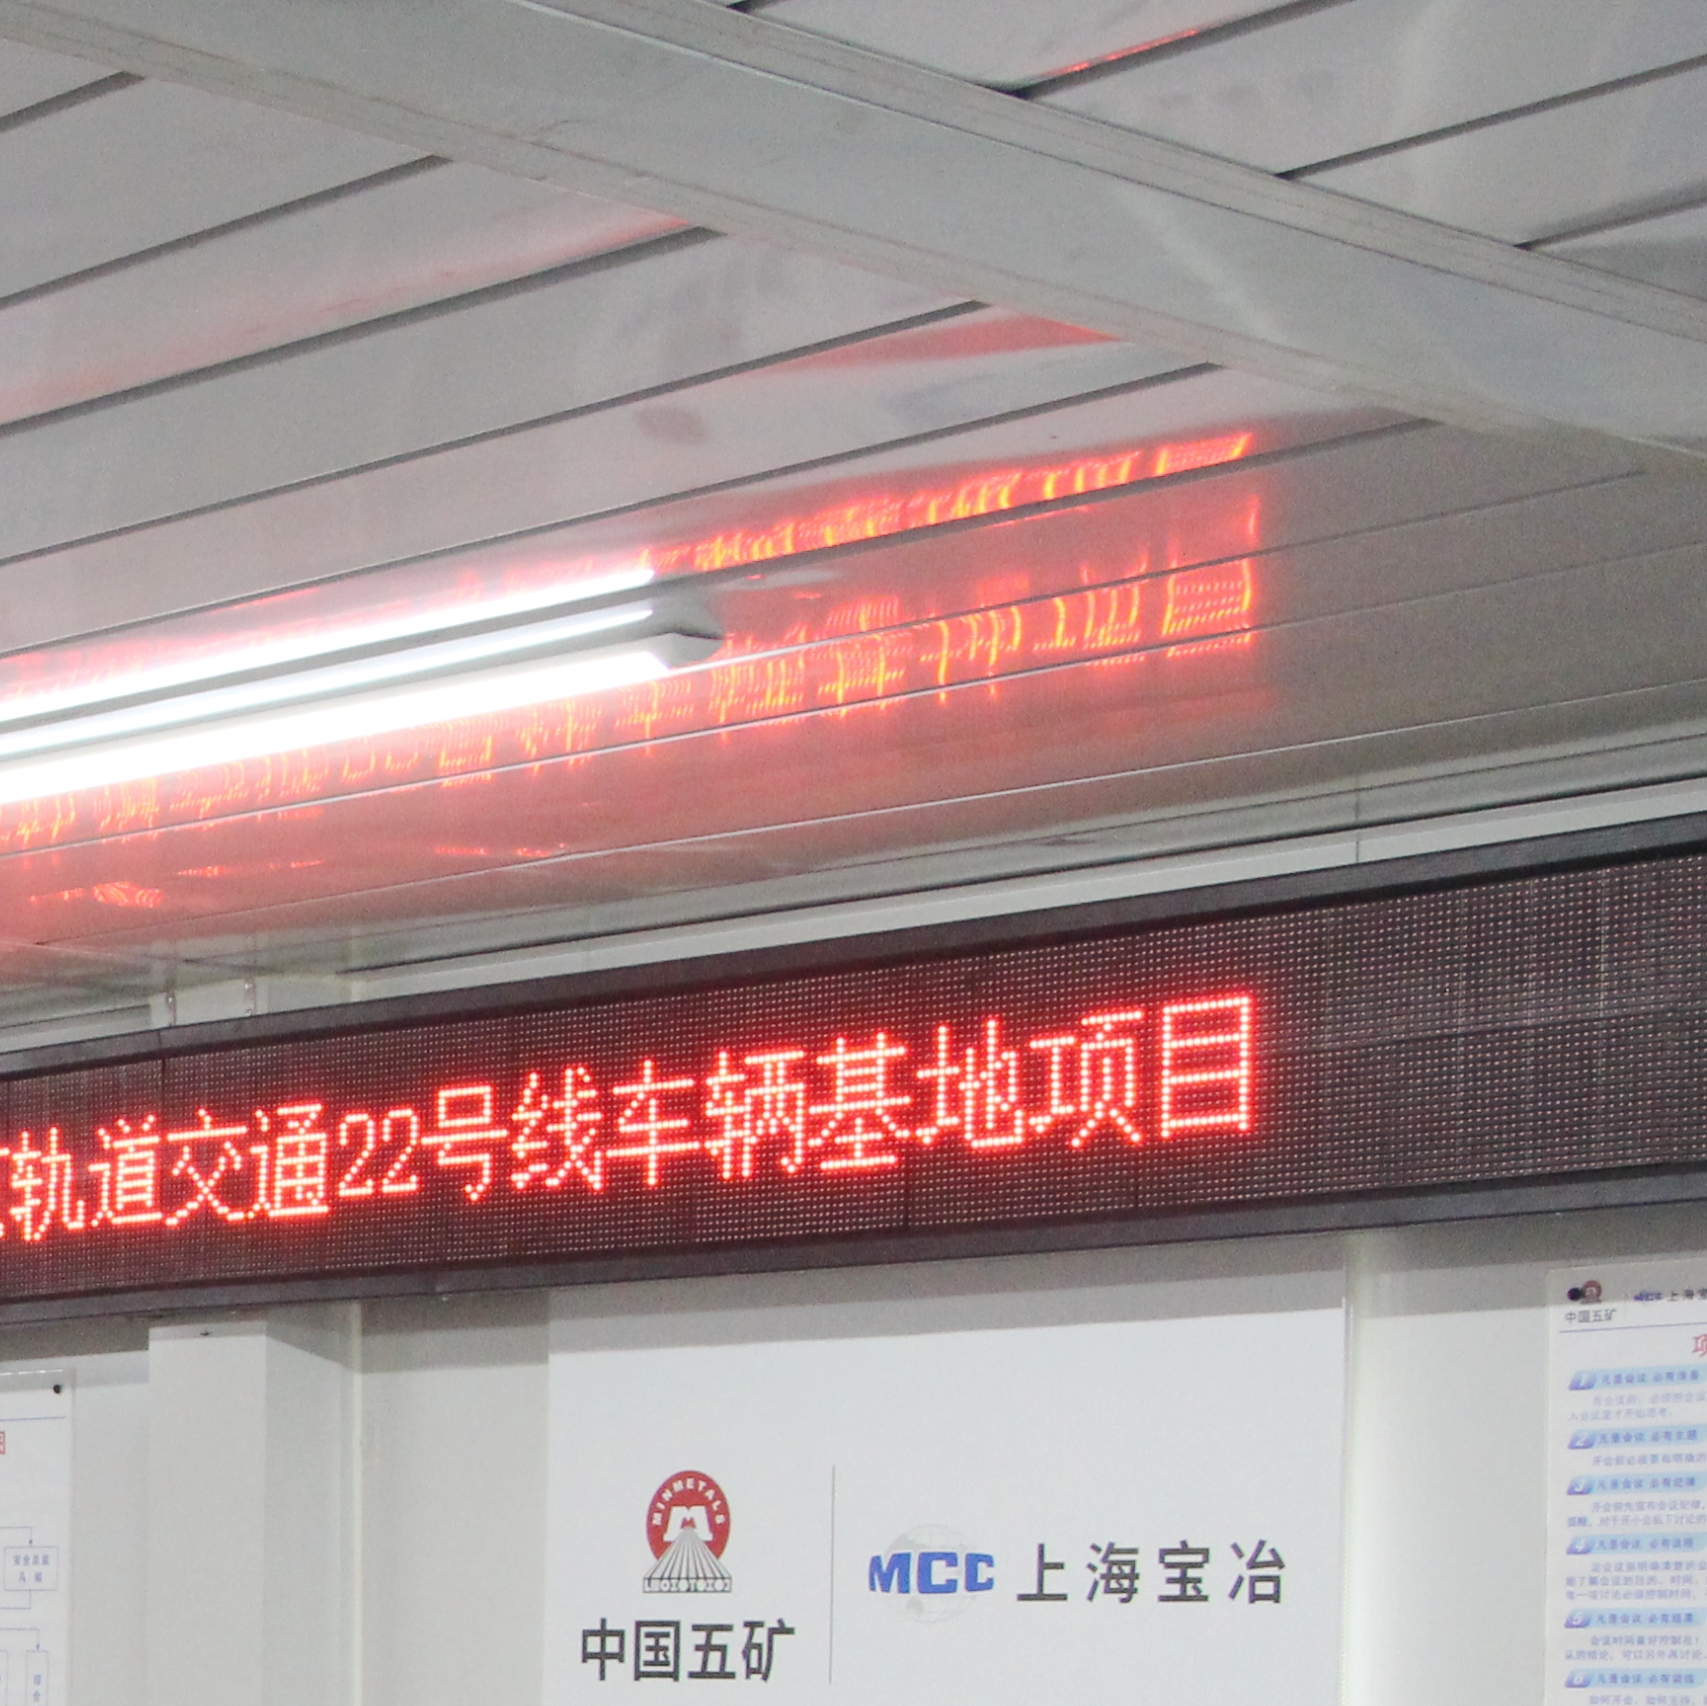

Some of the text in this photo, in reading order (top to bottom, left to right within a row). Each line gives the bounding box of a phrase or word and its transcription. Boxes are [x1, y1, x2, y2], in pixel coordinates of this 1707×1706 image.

[652, 1477, 724, 1526] MINMETALS
[867, 1539, 1286, 1605] MCC 上海宝冶
[580, 1617, 796, 1683] 中国五矿
